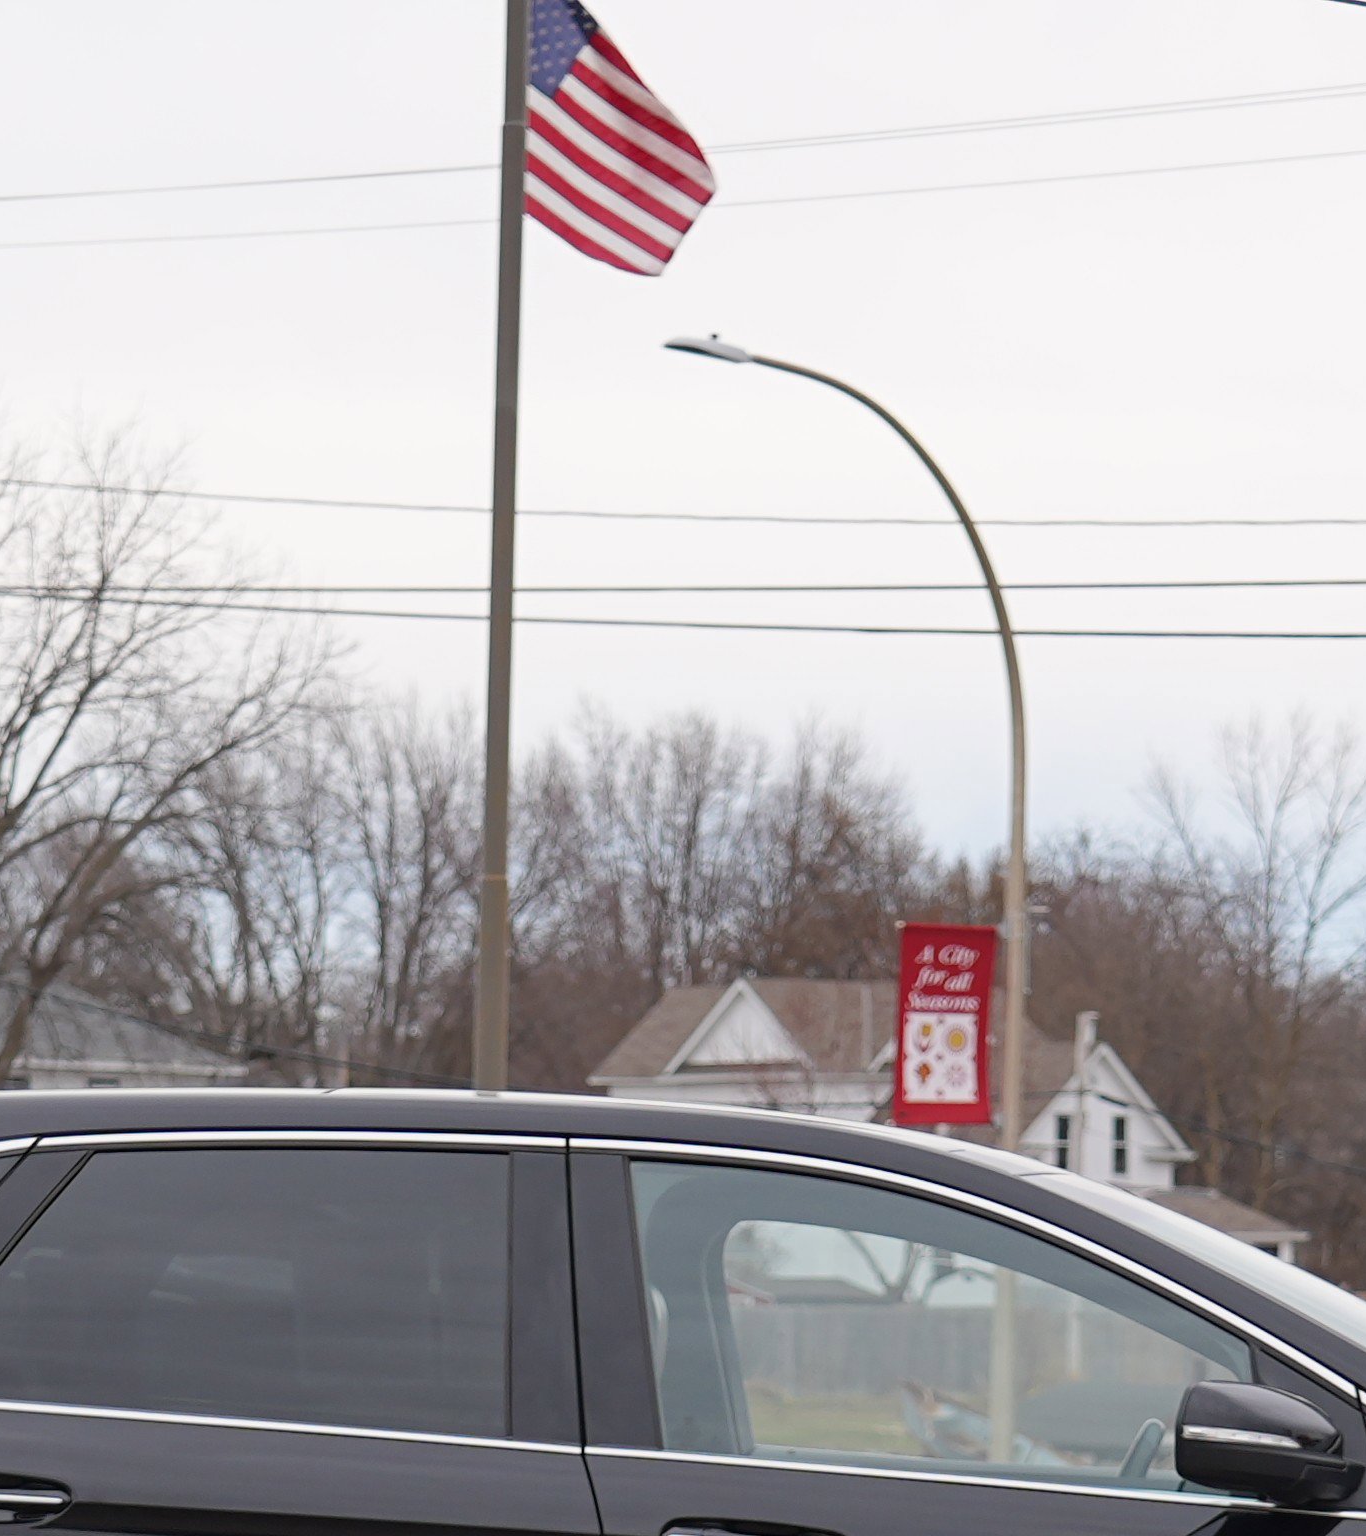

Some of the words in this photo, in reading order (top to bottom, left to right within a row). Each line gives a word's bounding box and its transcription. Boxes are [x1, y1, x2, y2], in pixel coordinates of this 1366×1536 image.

[914, 944, 934, 964] A
[938, 943, 980, 970] City
[911, 964, 949, 991] for
[943, 971, 975, 992] all
